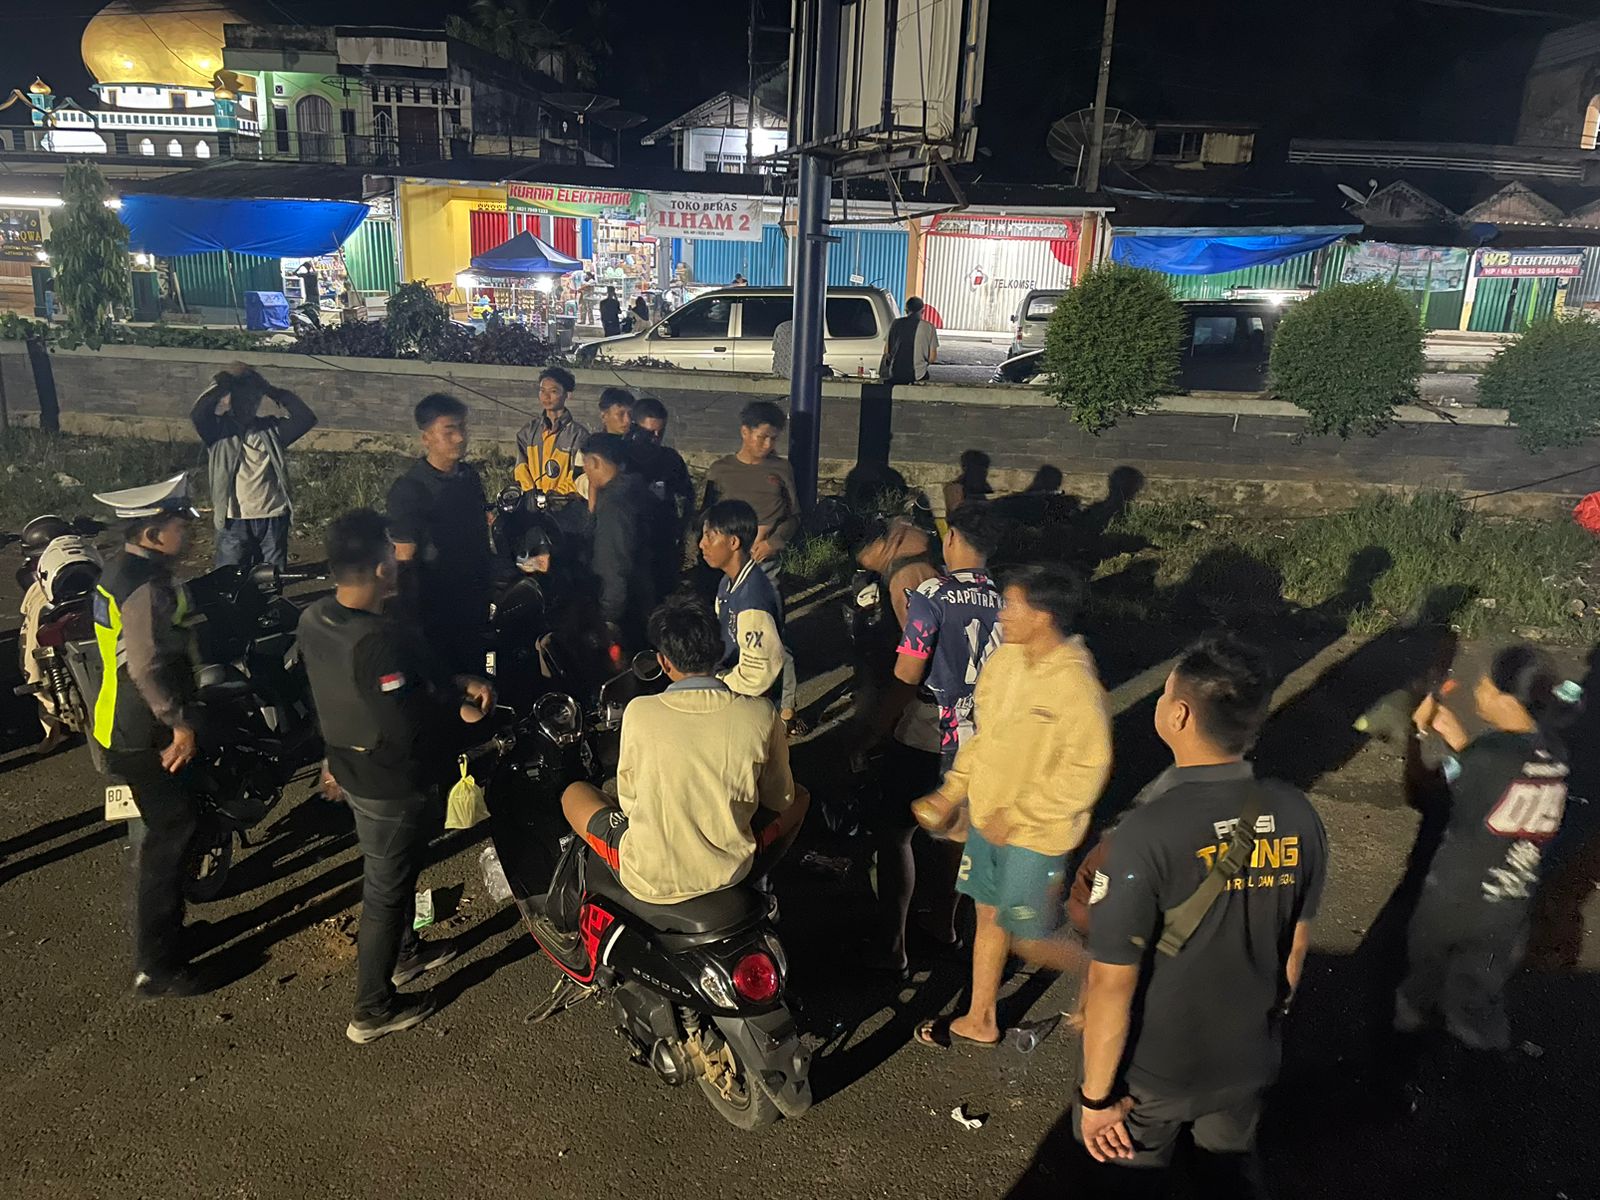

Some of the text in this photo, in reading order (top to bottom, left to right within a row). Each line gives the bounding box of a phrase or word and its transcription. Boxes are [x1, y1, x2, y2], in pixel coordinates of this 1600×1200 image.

[670, 200, 738, 212] TOKO BERAS
[658, 211, 751, 231] ILHAM 2
[1482, 253, 1510, 267] WB
[947, 590, 995, 609] SAPUTRA
